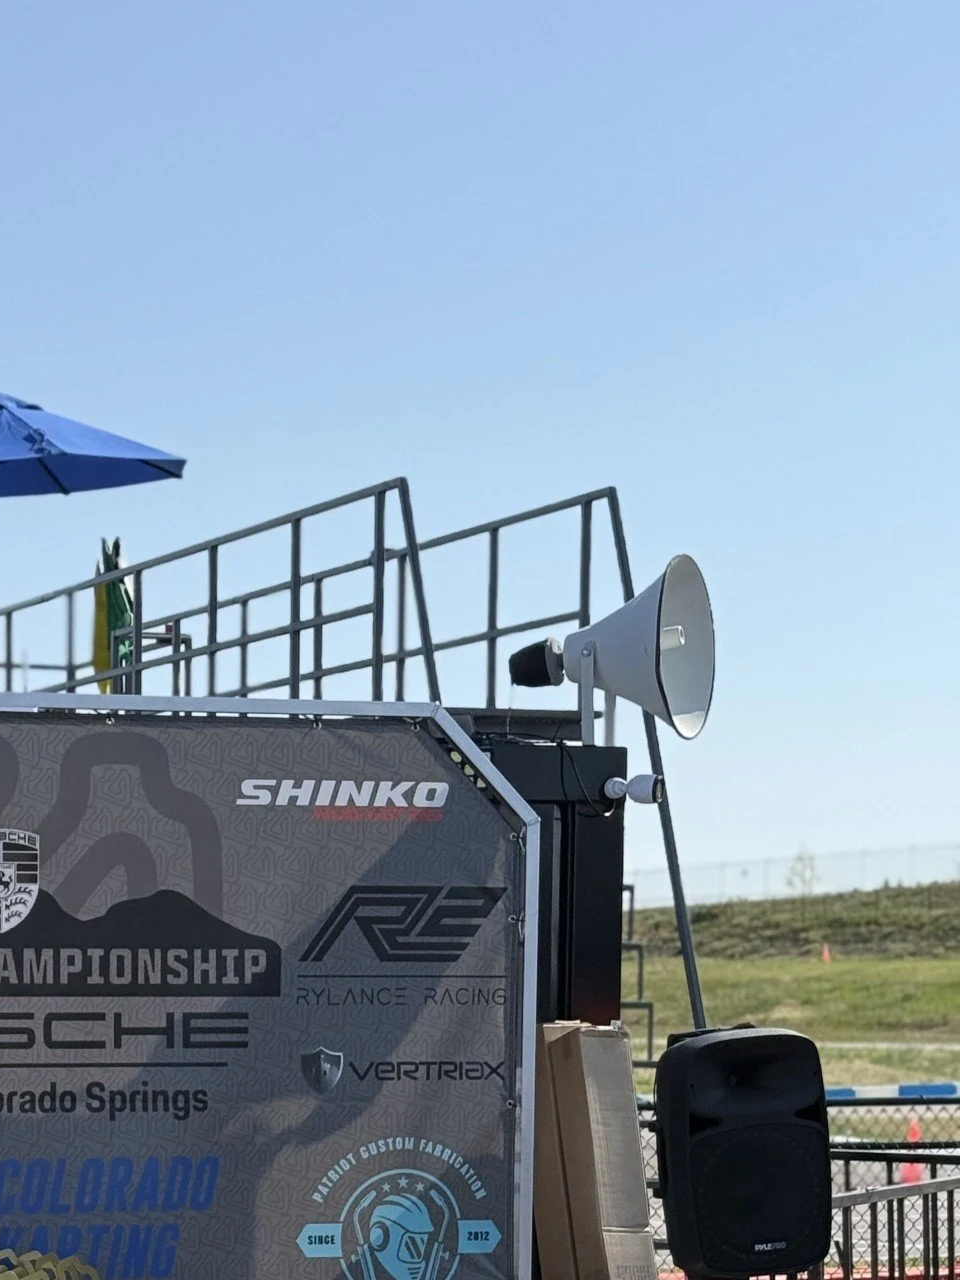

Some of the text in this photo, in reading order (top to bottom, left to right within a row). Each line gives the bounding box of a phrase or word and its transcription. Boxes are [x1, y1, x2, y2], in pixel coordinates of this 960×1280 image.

[236, 779, 449, 807] SHINKO
[296, 987, 507, 1006] RYLANCE RACING
[85, 1081, 209, 1121] Springs
[311, 1136, 487, 1203] PATRIOT CUSTOM FABRICATION
[307, 1231, 490, 1245] SINCE 2012
